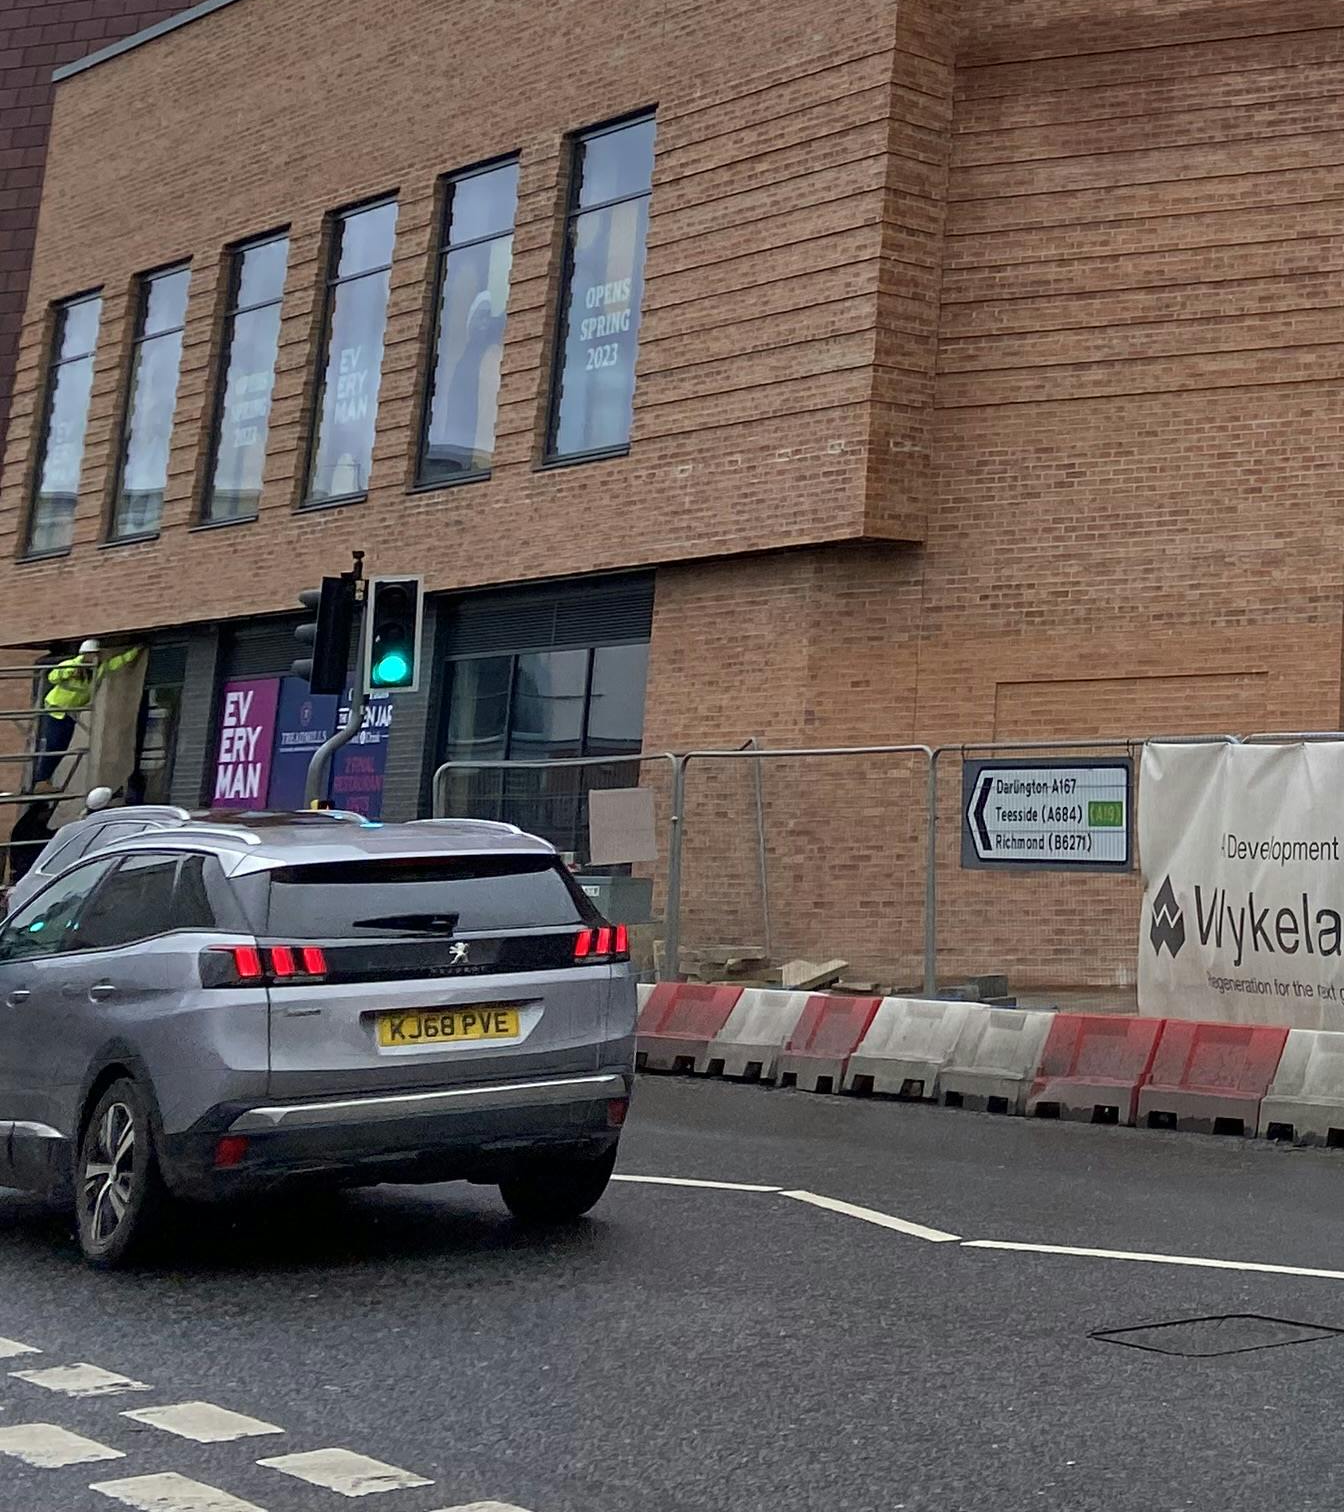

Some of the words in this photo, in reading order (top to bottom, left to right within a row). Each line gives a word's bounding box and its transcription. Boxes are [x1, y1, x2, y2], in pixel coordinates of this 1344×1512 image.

[586, 277, 631, 309] OPENS
[580, 309, 631, 341] SPRING
[340, 345, 362, 372] EV
[585, 343, 619, 370] 2023
[337, 371, 367, 398] ERY
[223, 690, 254, 727] EV
[219, 726, 263, 763] ERY
[215, 762, 262, 800] MAN
[996, 779, 1049, 797] Darlington
[1052, 778, 1077, 794] A167
[995, 806, 1038, 822] Teesside
[1042, 804, 1082, 824] (A684)
[996, 834, 1045, 850] Richmond
[1048, 833, 1092, 852] (B6271)
[1227, 834, 1339, 867] Development
[1274, 978, 1290, 997] for
[1292, 981, 1314, 998] the
[390, 1016, 455, 1041] KJ68
[462, 1011, 509, 1035] PVE
